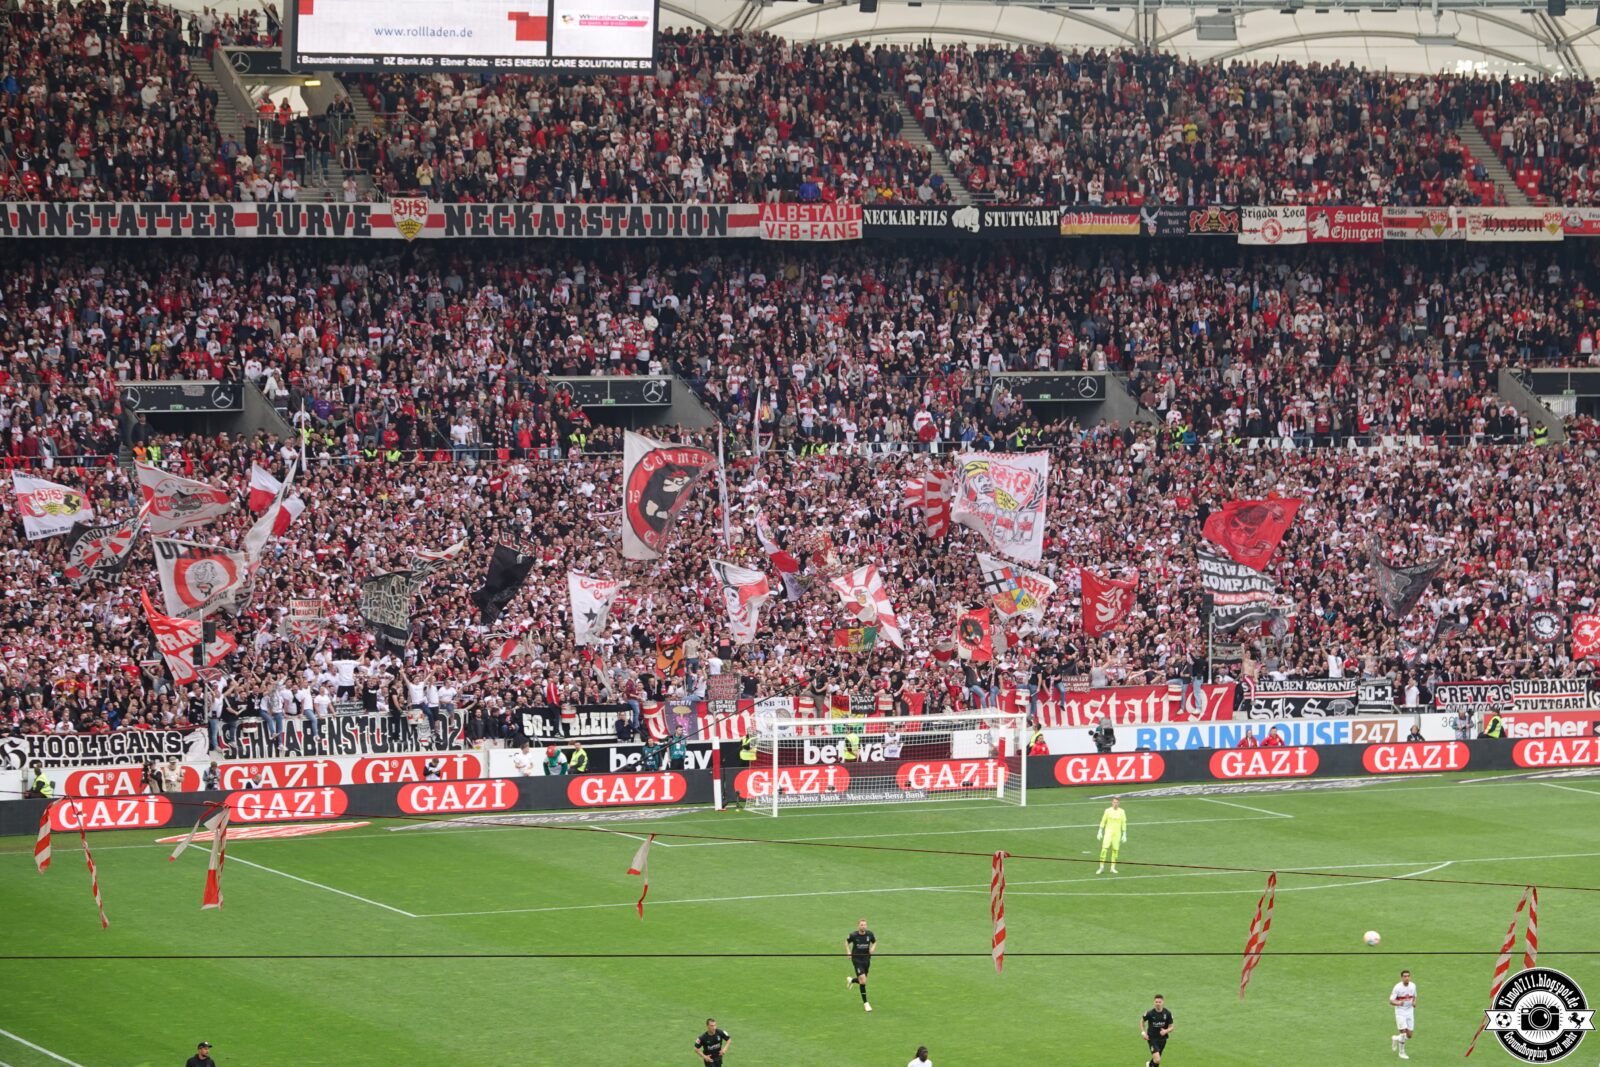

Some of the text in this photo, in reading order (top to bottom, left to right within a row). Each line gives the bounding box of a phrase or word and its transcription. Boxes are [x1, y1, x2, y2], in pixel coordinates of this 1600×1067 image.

[374, 26, 473, 38] www.rollladen.de
[301, 56, 652, 69] Bauunternehmen DZ Bank AG Ebner Stolz ECS ENERGY CARE SOLUTION DIE EN
[256, 204, 371, 236] KURVE
[762, 204, 860, 221] ALBSTADT
[863, 208, 1060, 227] NECKAR-FILS STUTTGART
[1081, 211, 1130, 226] Warriors
[1282, 206, 1306, 218] Loca
[444, 205, 728, 237] NECKARSTADION
[1483, 213, 1543, 236] Hessen
[765, 221, 859, 239] VFB-FANS
[1242, 680, 1357, 692] SHWABEN KOMPANIE
[1358, 686, 1394, 701] 50+1
[1438, 685, 1512, 704] CREW 36
[1514, 678, 1585, 695] SÜDBANDE
[1515, 697, 1586, 711] STUTTGART
[1354, 722, 1396, 744] 247
[26, 731, 182, 758] HOOLIGANS
[821, 793, 841, 802] Bank
[905, 790, 926, 799] Bank
